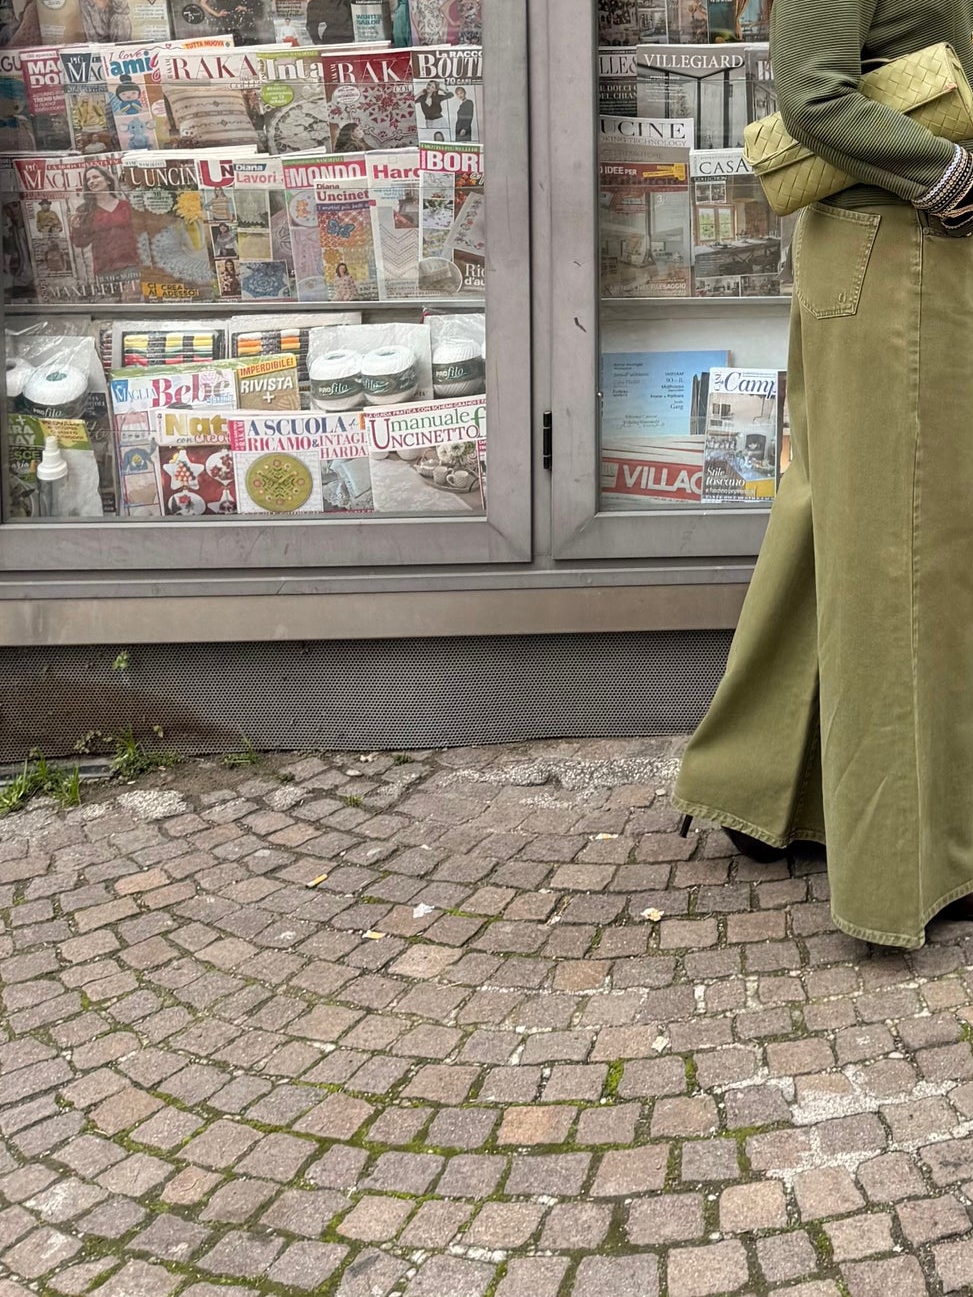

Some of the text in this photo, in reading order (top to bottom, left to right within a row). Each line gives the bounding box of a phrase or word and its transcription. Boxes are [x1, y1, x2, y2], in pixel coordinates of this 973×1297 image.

[204, 40, 225, 48] NUOVA
[119, 49, 141, 61] love
[605, 165, 624, 175] IDEE
[236, 171, 277, 184] Lavori
[162, 290, 198, 298] ADESSO!
[240, 358, 294, 377] IMPERDIBILE!
[241, 377, 293, 394] RIVISTA
[248, 417, 346, 438] A SCUOLA
[390, 411, 471, 433] manuale
[246, 437, 312, 451] RICAMO
[707, 467, 726, 478] Stile
